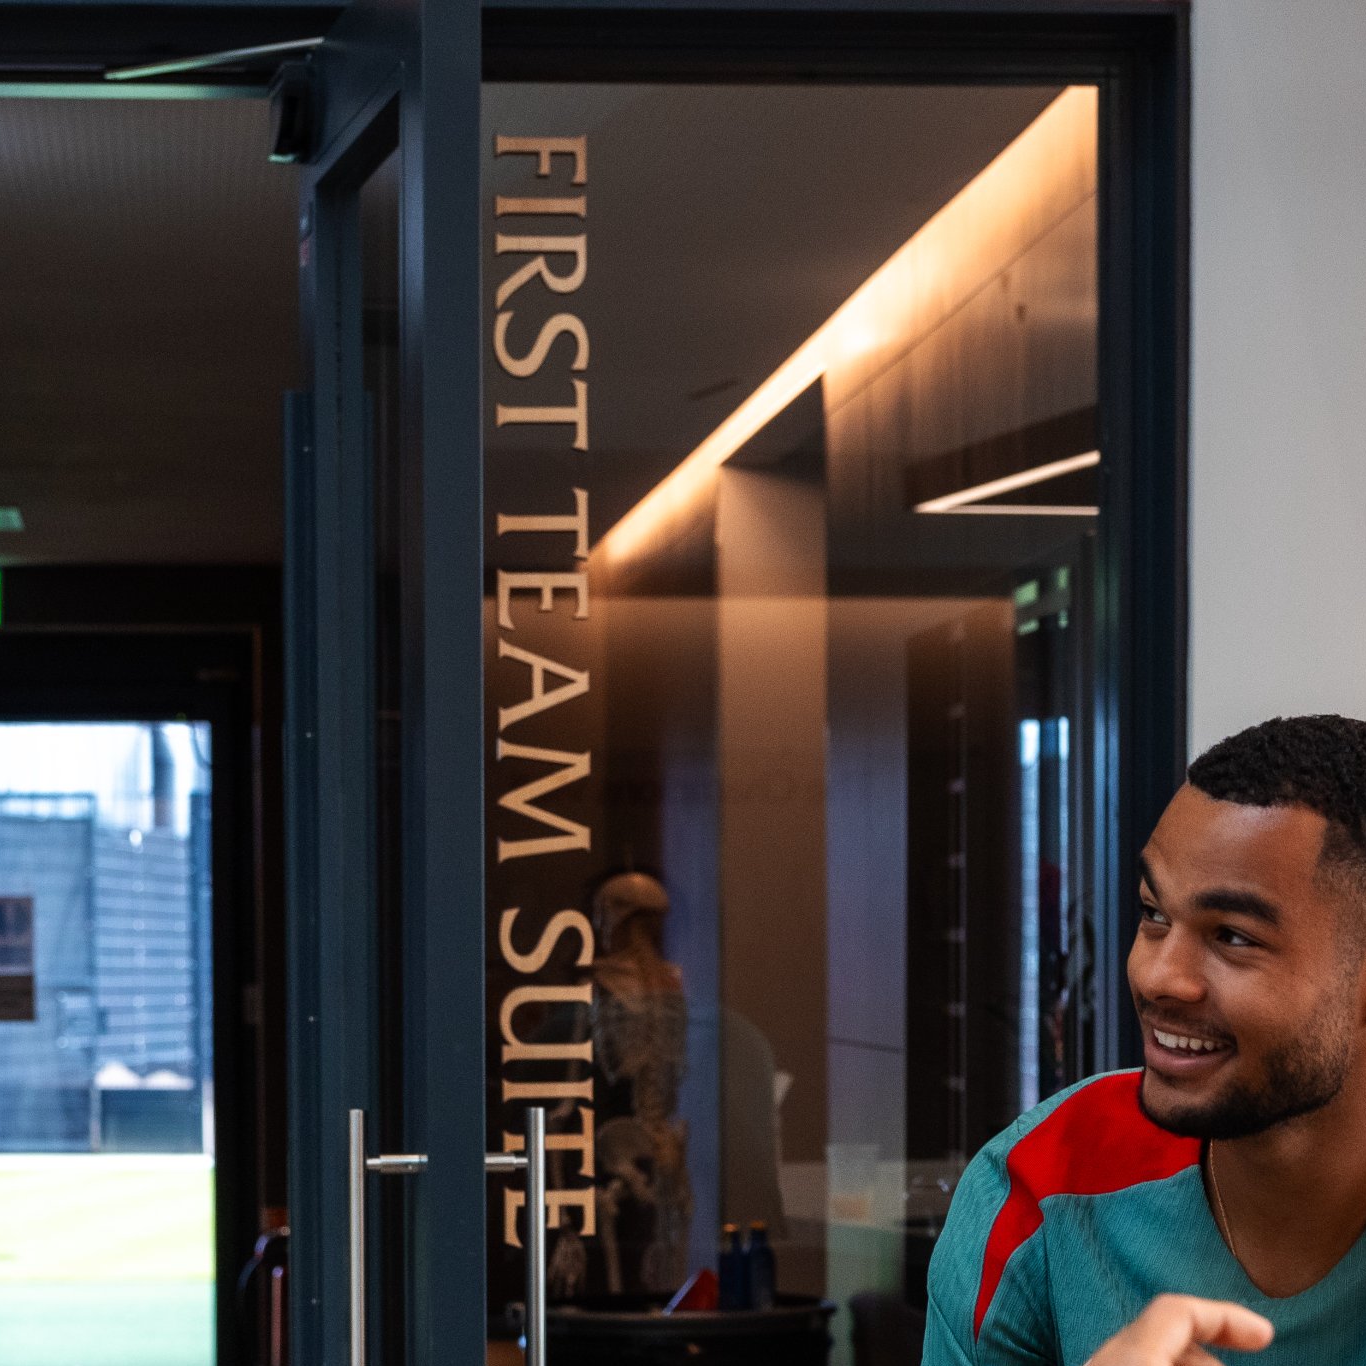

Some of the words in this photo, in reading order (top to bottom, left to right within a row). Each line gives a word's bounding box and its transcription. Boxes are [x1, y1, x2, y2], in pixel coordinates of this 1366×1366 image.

[494, 135, 590, 451] FIRST
[496, 487, 592, 863] TEAM
[499, 907, 596, 1248] SUITE
